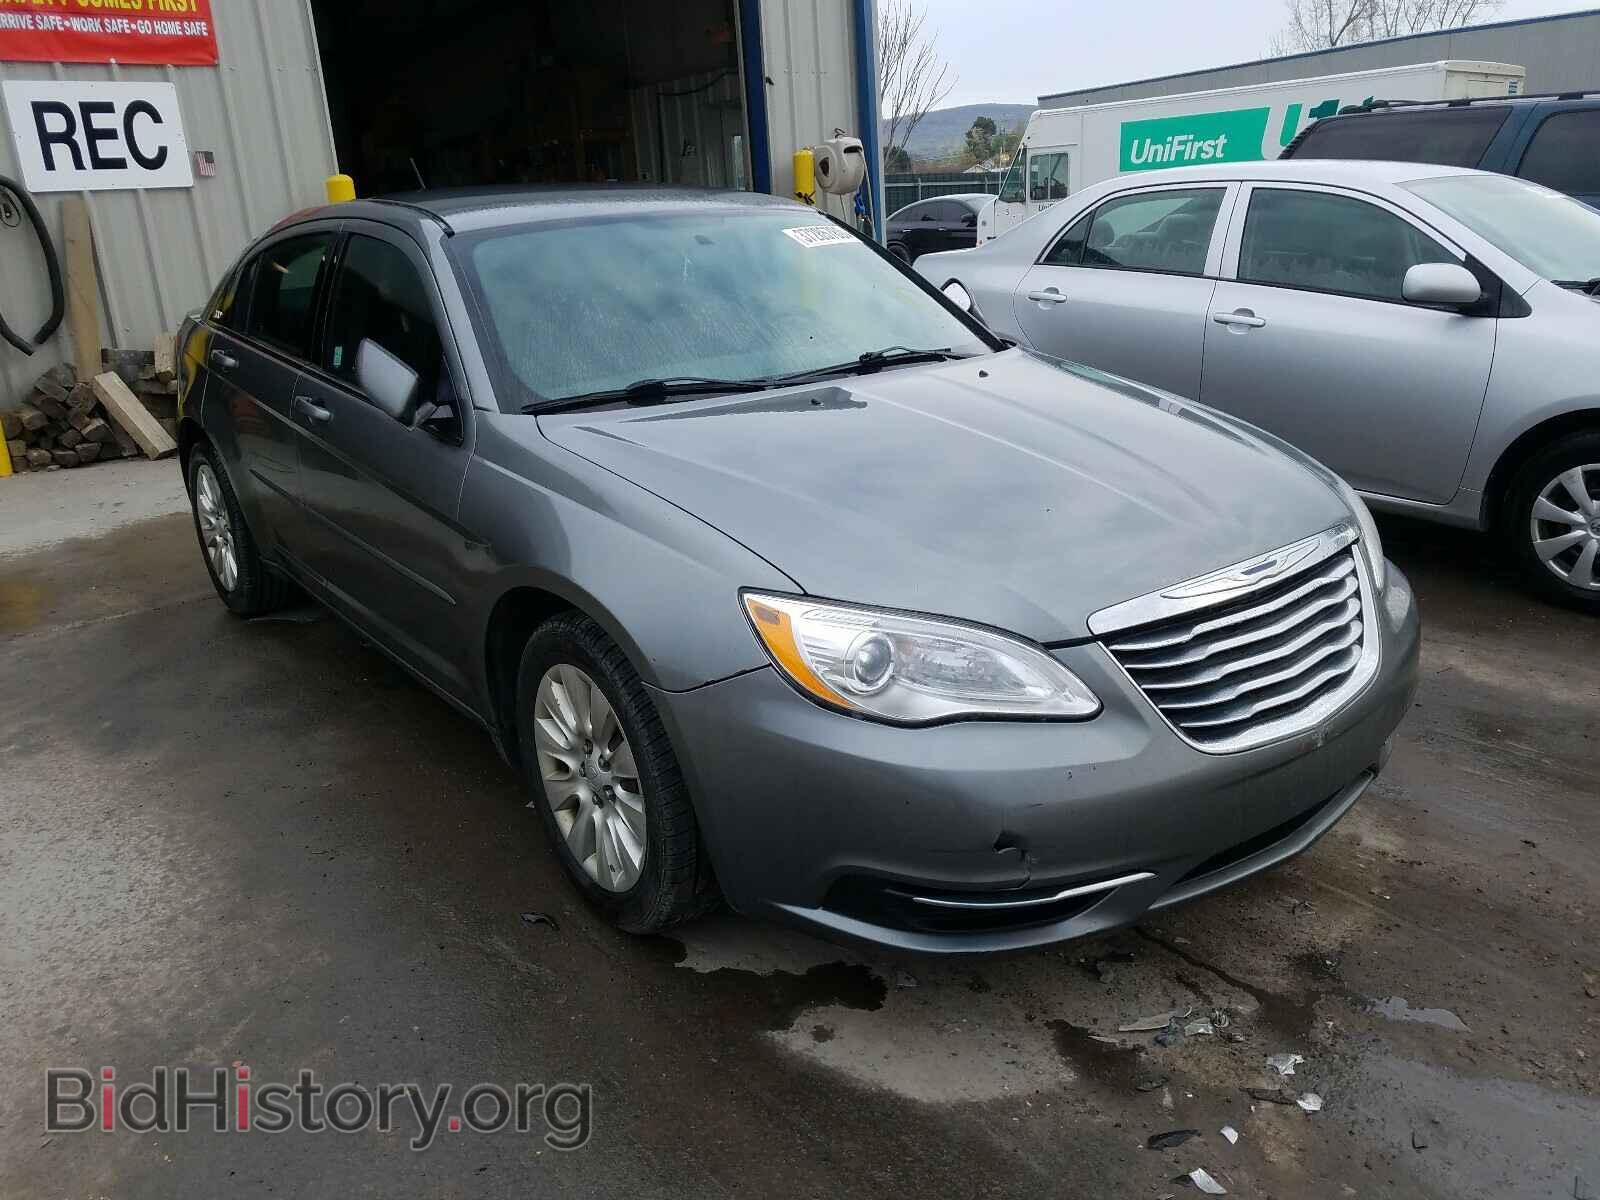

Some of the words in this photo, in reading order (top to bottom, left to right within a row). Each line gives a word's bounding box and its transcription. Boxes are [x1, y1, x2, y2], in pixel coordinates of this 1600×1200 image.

[137, 20, 152, 34] GO
[153, 21, 183, 35] HOME
[183, 22, 208, 36] SAFE
[31, 100, 168, 171] REC
[1130, 134, 1227, 165] UniFirst
